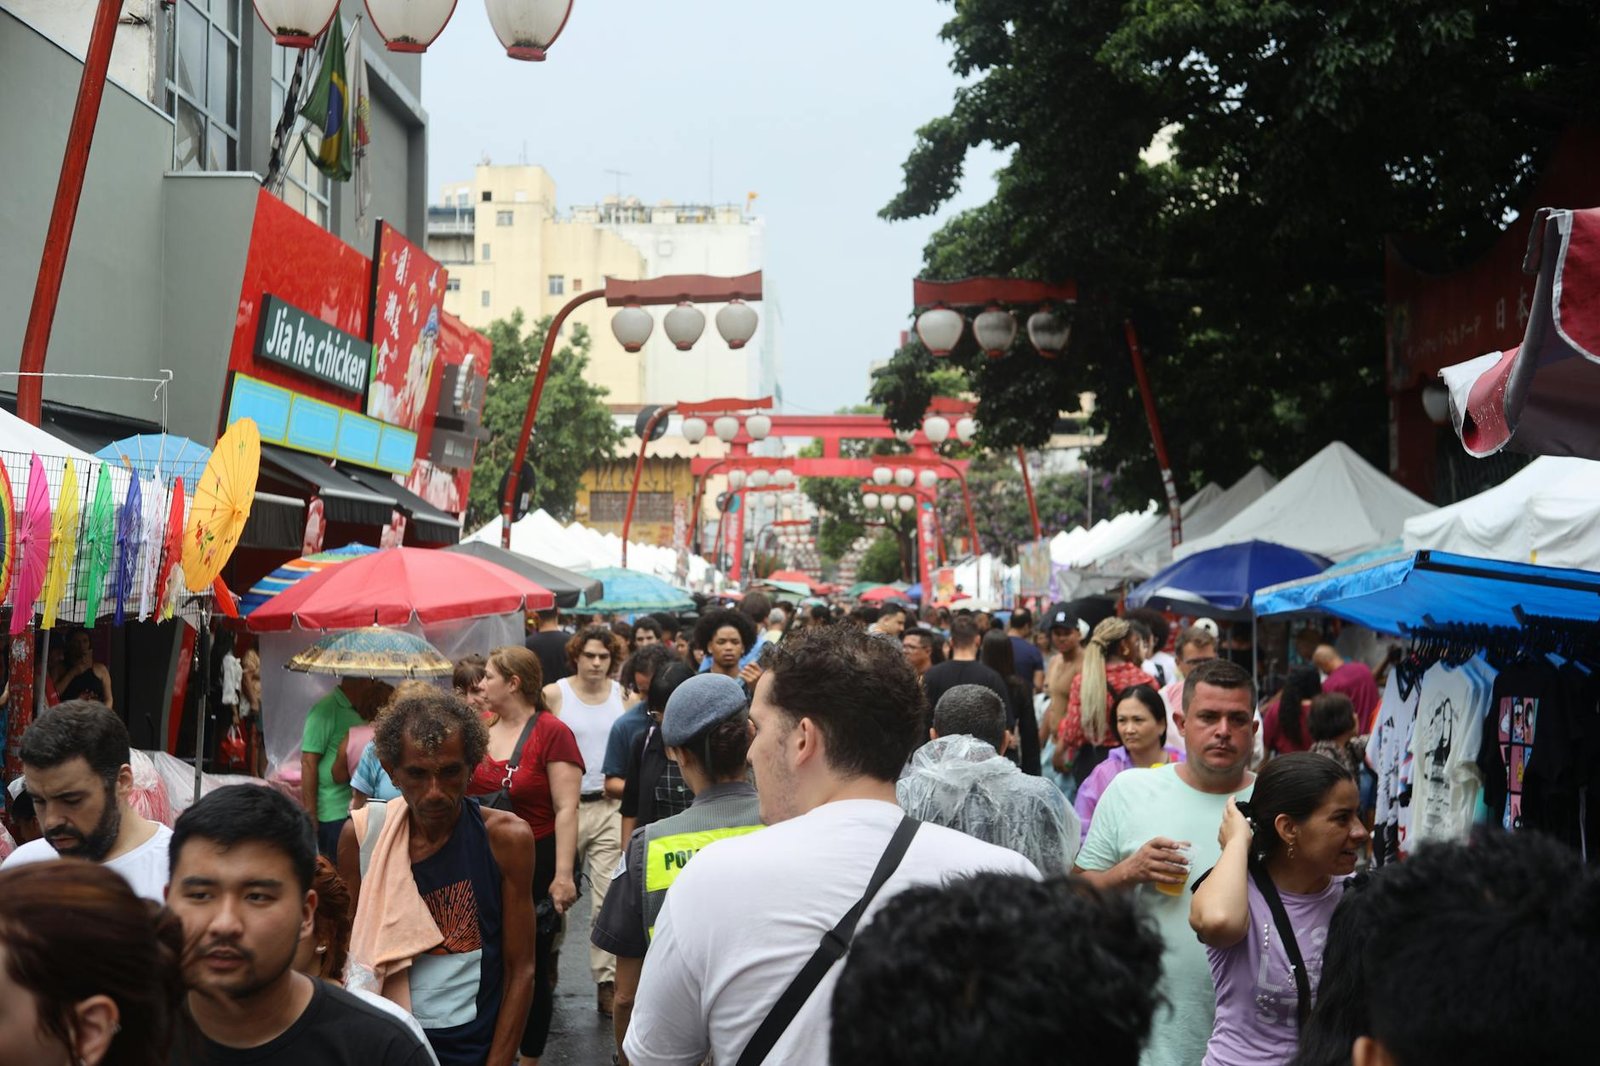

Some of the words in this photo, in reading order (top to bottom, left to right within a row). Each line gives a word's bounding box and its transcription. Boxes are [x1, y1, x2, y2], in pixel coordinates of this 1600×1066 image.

[266, 306, 293, 360] Jia
[292, 317, 315, 369] he
[314, 330, 367, 390] chicken
[664, 849, 700, 871] PO
